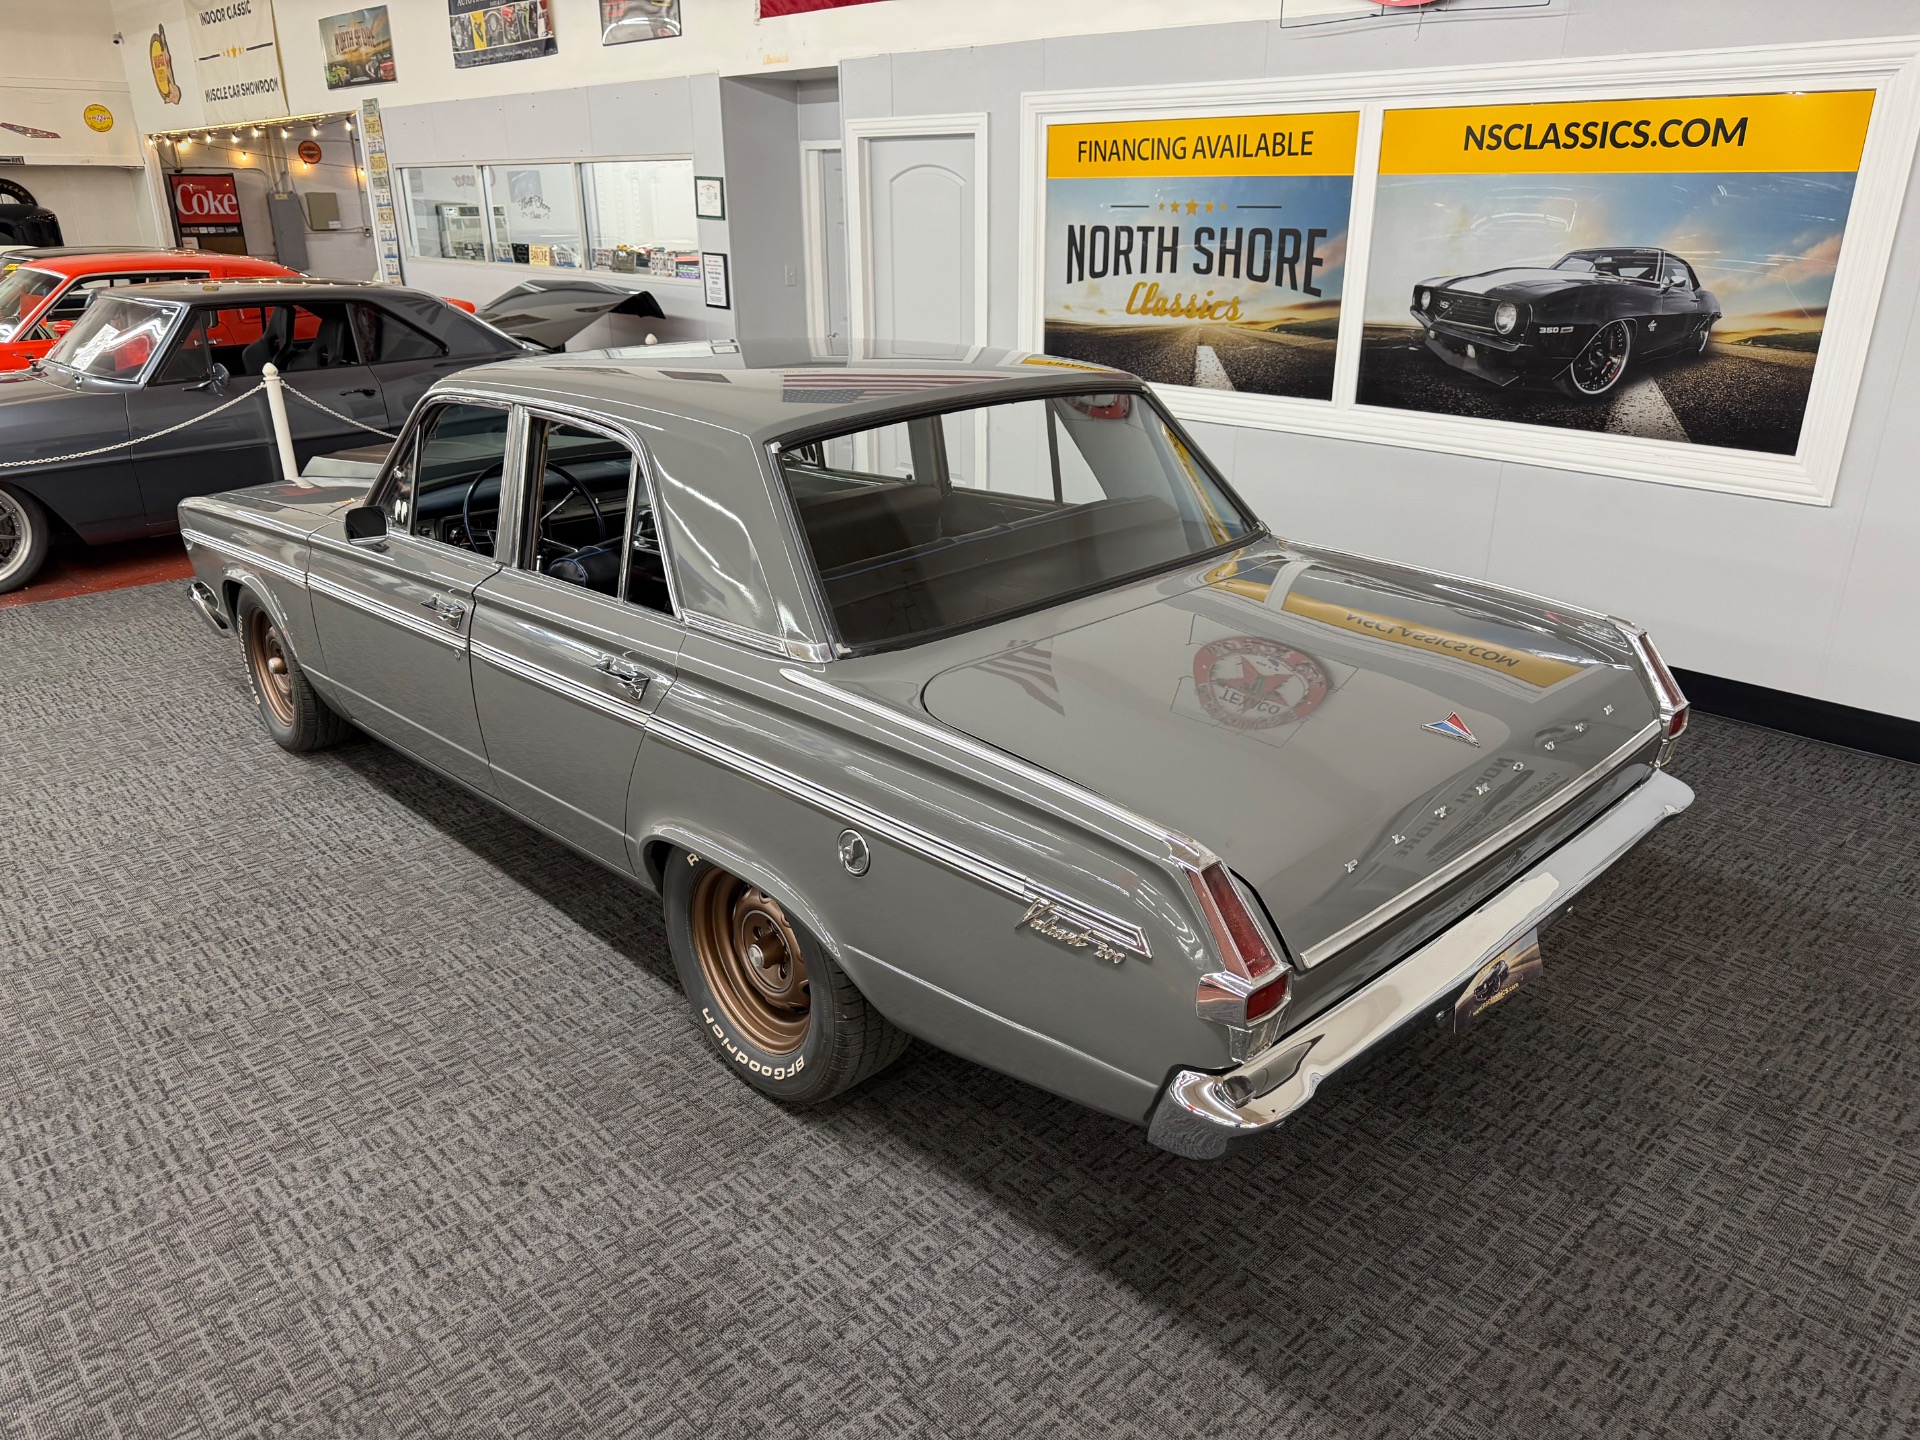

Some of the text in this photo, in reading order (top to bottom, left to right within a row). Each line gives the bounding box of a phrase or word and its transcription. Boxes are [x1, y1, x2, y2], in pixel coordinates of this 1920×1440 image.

[199, 0, 251, 26] INDOOR CLASSIC
[205, 77, 279, 102] MUSCLE CAR SHOWROOM
[1077, 130, 1314, 163] FINANCING AVAILABLE
[1463, 117, 1749, 151] NSCLASSICS.COM
[175, 183, 240, 215] Coke
[1066, 224, 1328, 298] NORTH SHORE
[1125, 281, 1244, 322] Classics
[701, 1007, 806, 1081] BFGoodrich
